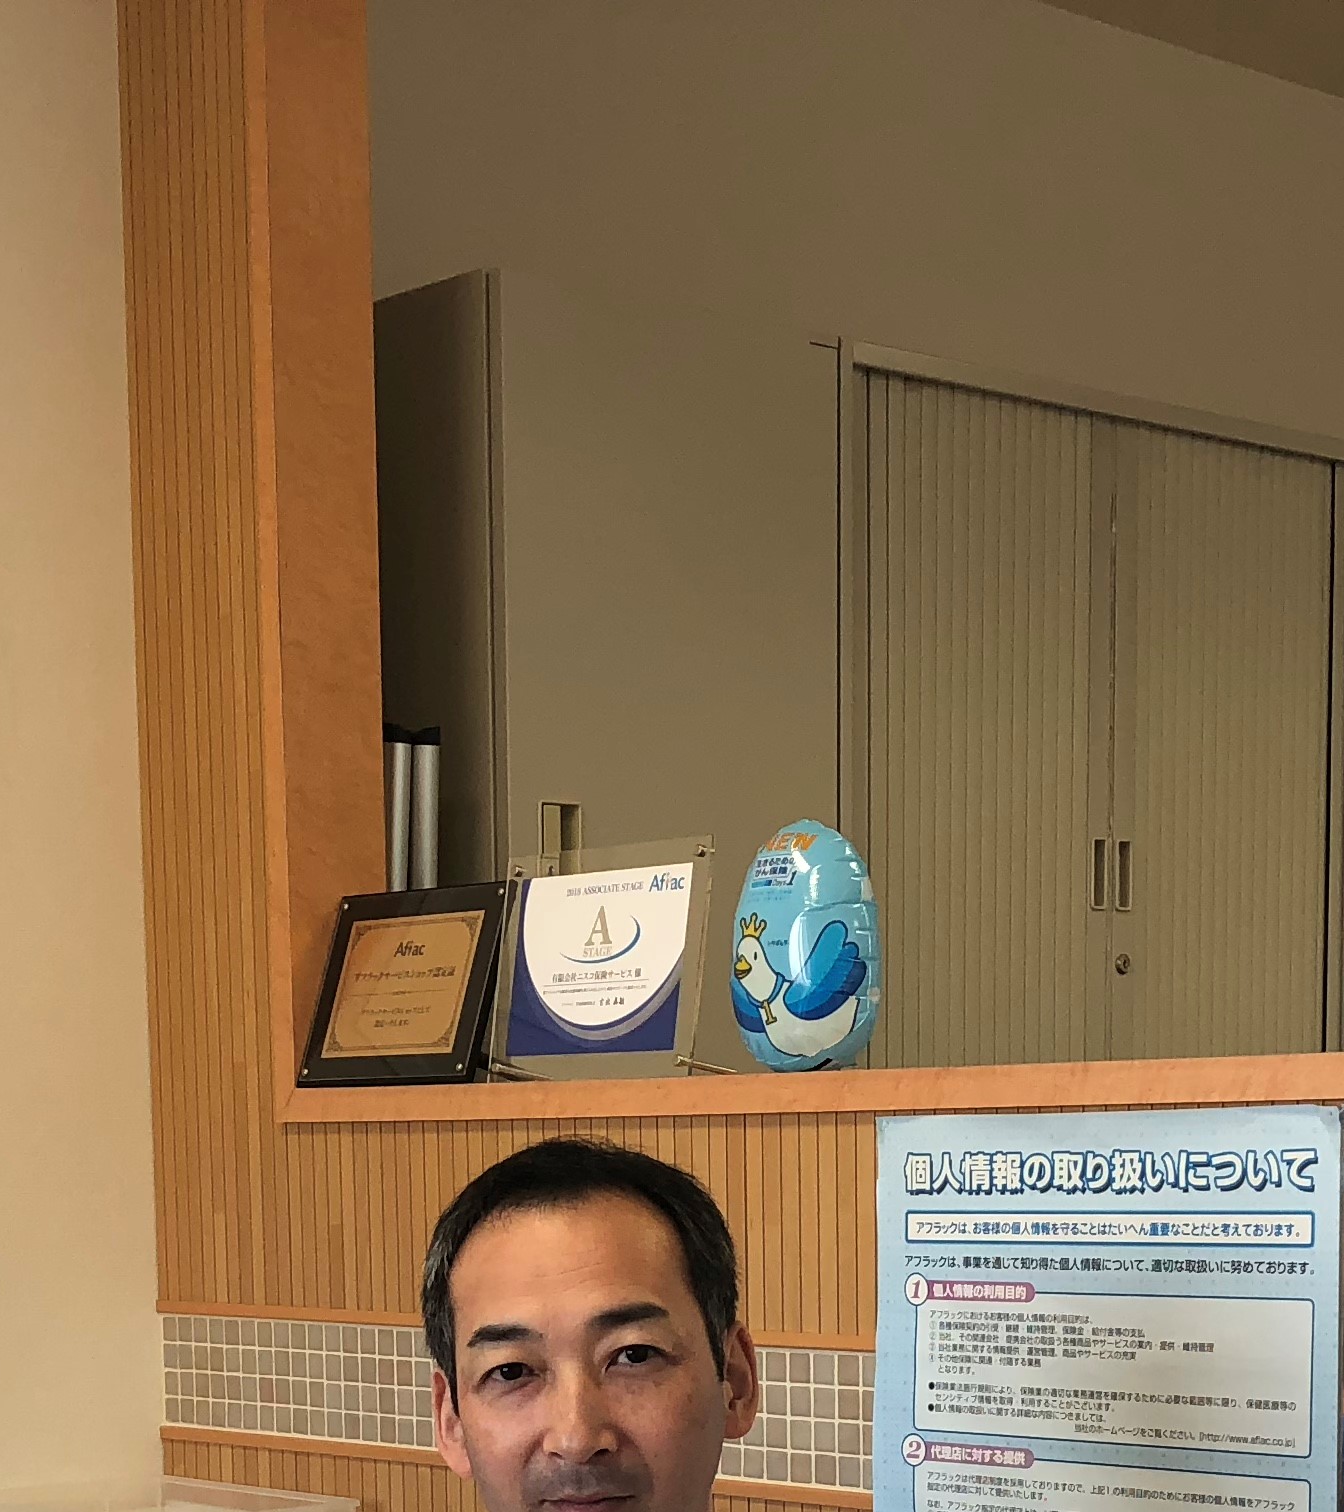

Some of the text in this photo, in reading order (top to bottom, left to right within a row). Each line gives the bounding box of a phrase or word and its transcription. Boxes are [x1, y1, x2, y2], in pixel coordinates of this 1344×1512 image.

[582, 884, 620, 896] ASSOCIATE
[621, 881, 644, 892] STAGE
[584, 905, 613, 947] A
[582, 946, 613, 958] STAGE
[904, 1148, 1317, 1197] 個人情報の取り扱いについて
[915, 1219, 1303, 1240] アフラックは、お客様の個人情報を守ることはたいへん重要なことだと考えております。
[904, 1253, 1316, 1276] アフラックは、事業を通じて知り得た個人情報について、適切な取扱いに努めております。
[932, 1283, 1027, 1300] 個人情報の利用目的
[937, 1364, 976, 1375] となります。
[906, 1440, 1025, 1466] 2 代理店に対する提供
